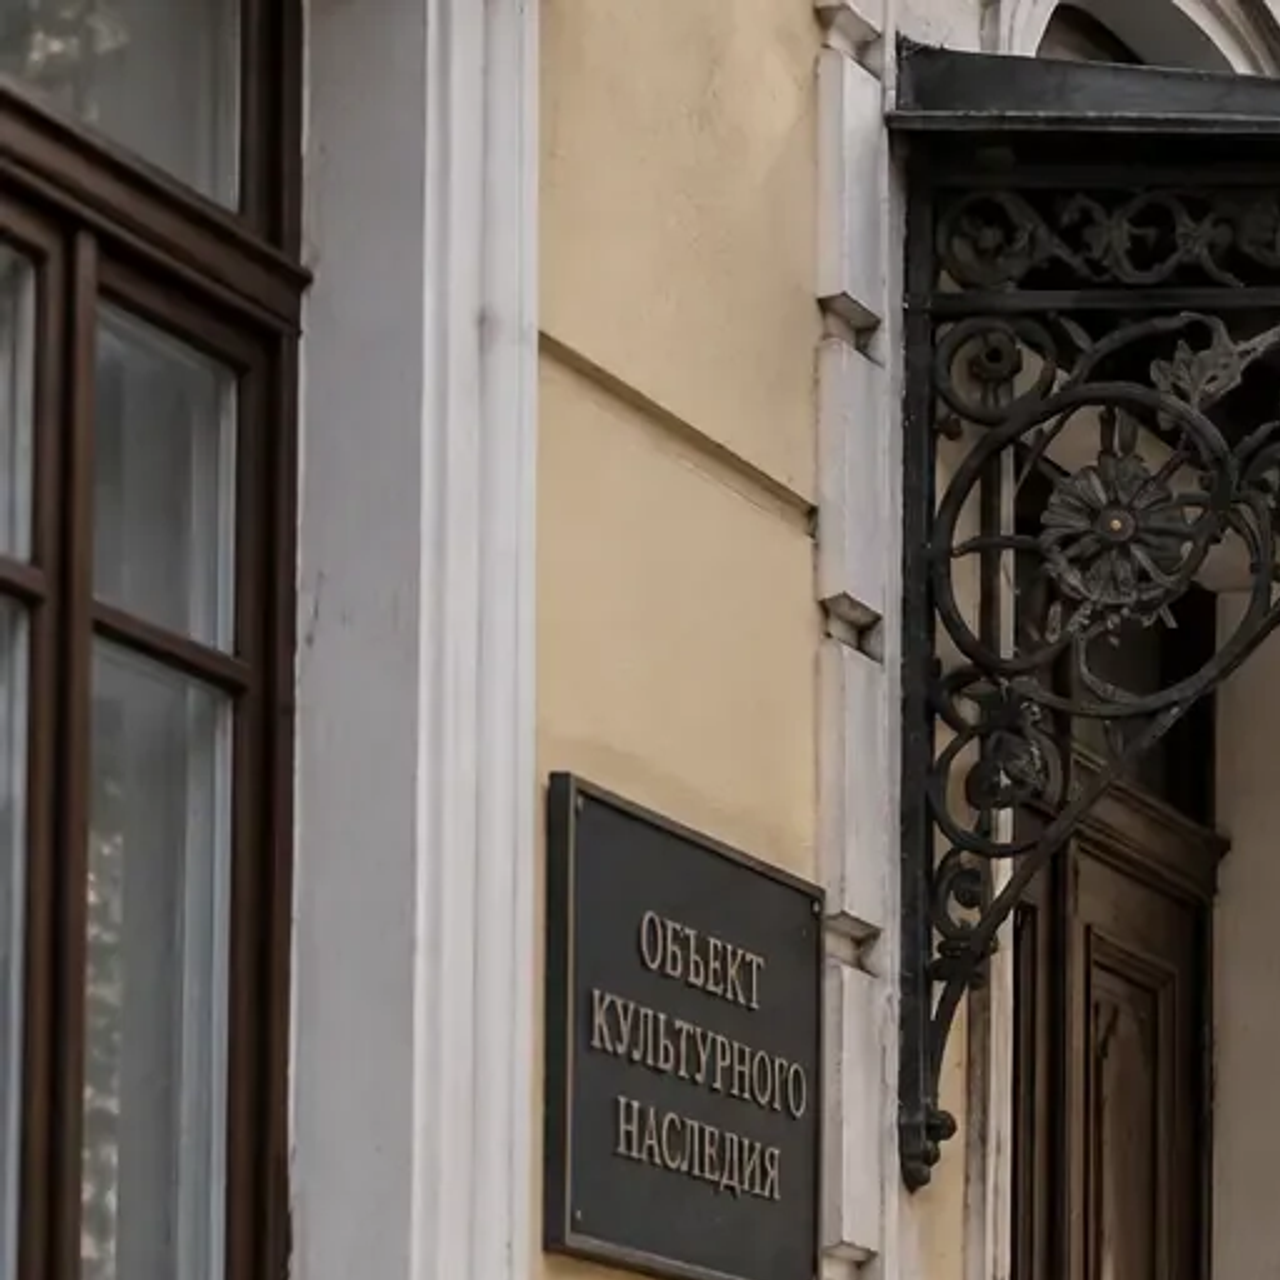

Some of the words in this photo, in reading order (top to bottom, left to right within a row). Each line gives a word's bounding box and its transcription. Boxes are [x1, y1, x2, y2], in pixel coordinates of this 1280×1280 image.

[640, 910, 764, 1010] ОБЪЕКТ
[590, 988, 806, 1119] КУЛЬТУРНОГО
[616, 1095, 781, 1201] НАСЛЕДИЯ
